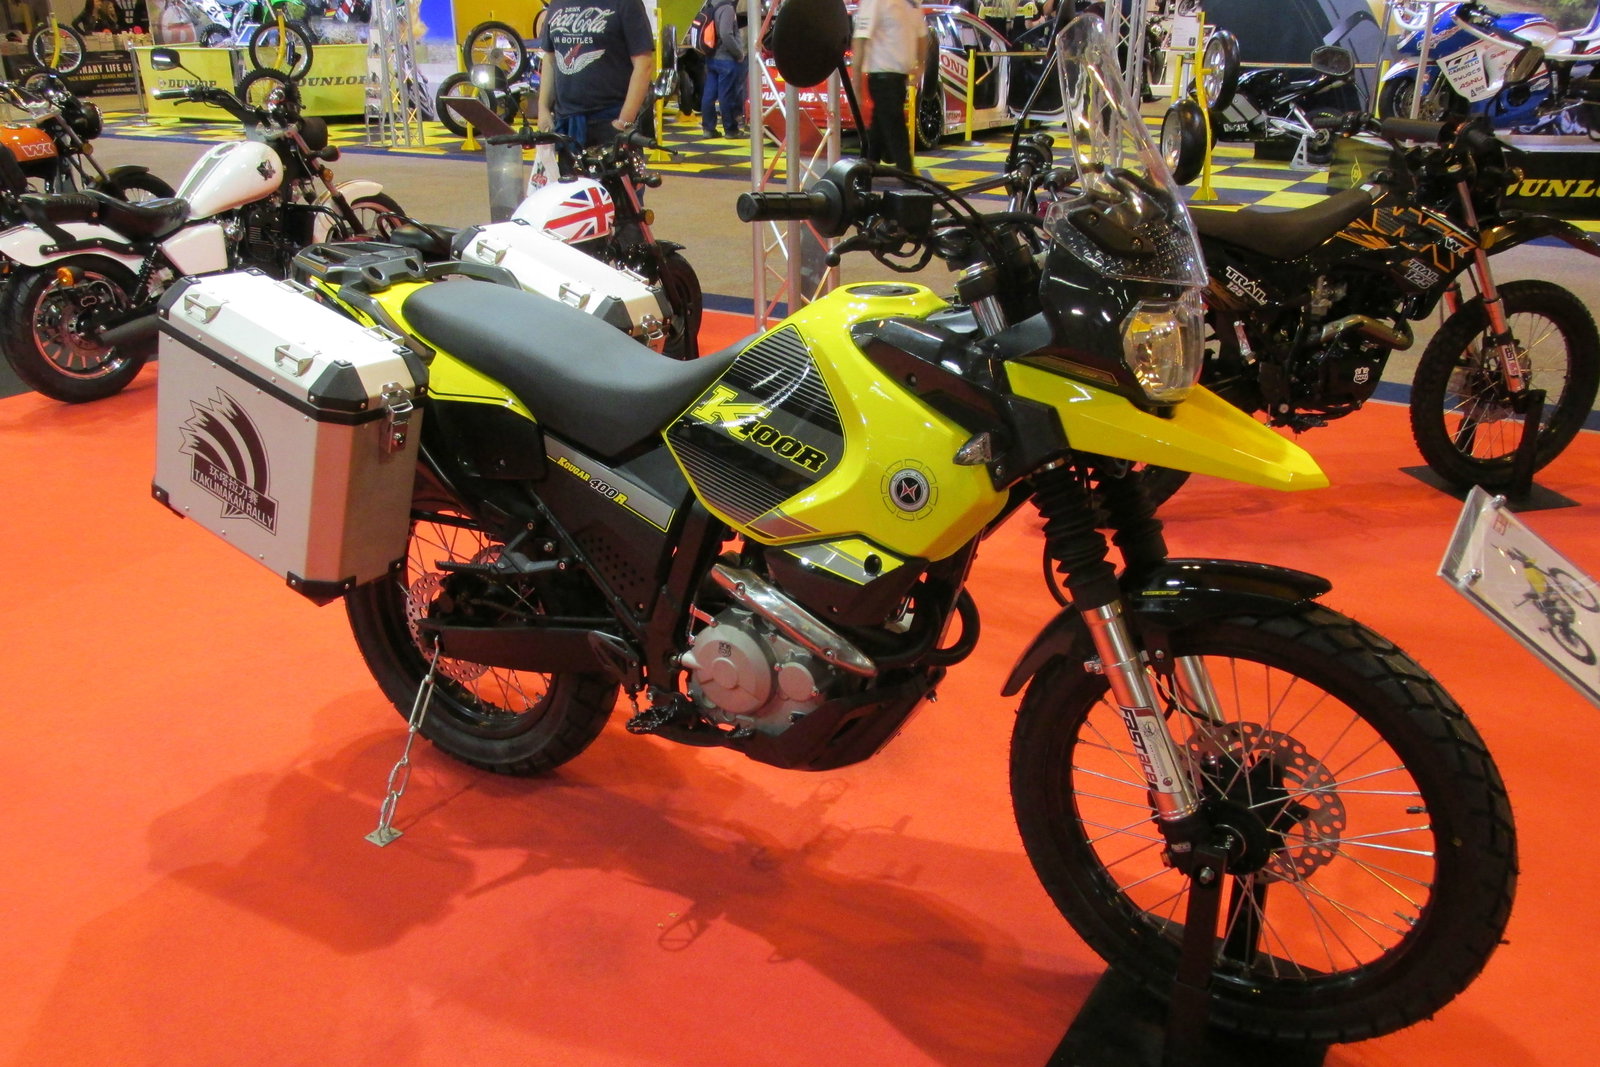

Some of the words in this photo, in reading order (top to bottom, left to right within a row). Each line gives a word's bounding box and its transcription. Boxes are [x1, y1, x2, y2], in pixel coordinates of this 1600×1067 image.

[105, 63, 121, 73] LIFE
[940, 54, 969, 78] OND
[21, 142, 54, 157] WK
[1506, 179, 1600, 198] UNL
[1404, 269, 1438, 290] 125
[1407, 258, 1440, 284] TRAIL
[1225, 265, 1268, 306] TRAIL
[1226, 281, 1246, 297] 125
[557, 456, 592, 482] KOUGAR
[588, 478, 629, 505] 400R
[194, 468, 246, 510] TAKLIMAKAN
[245, 502, 274, 529] RALLY
